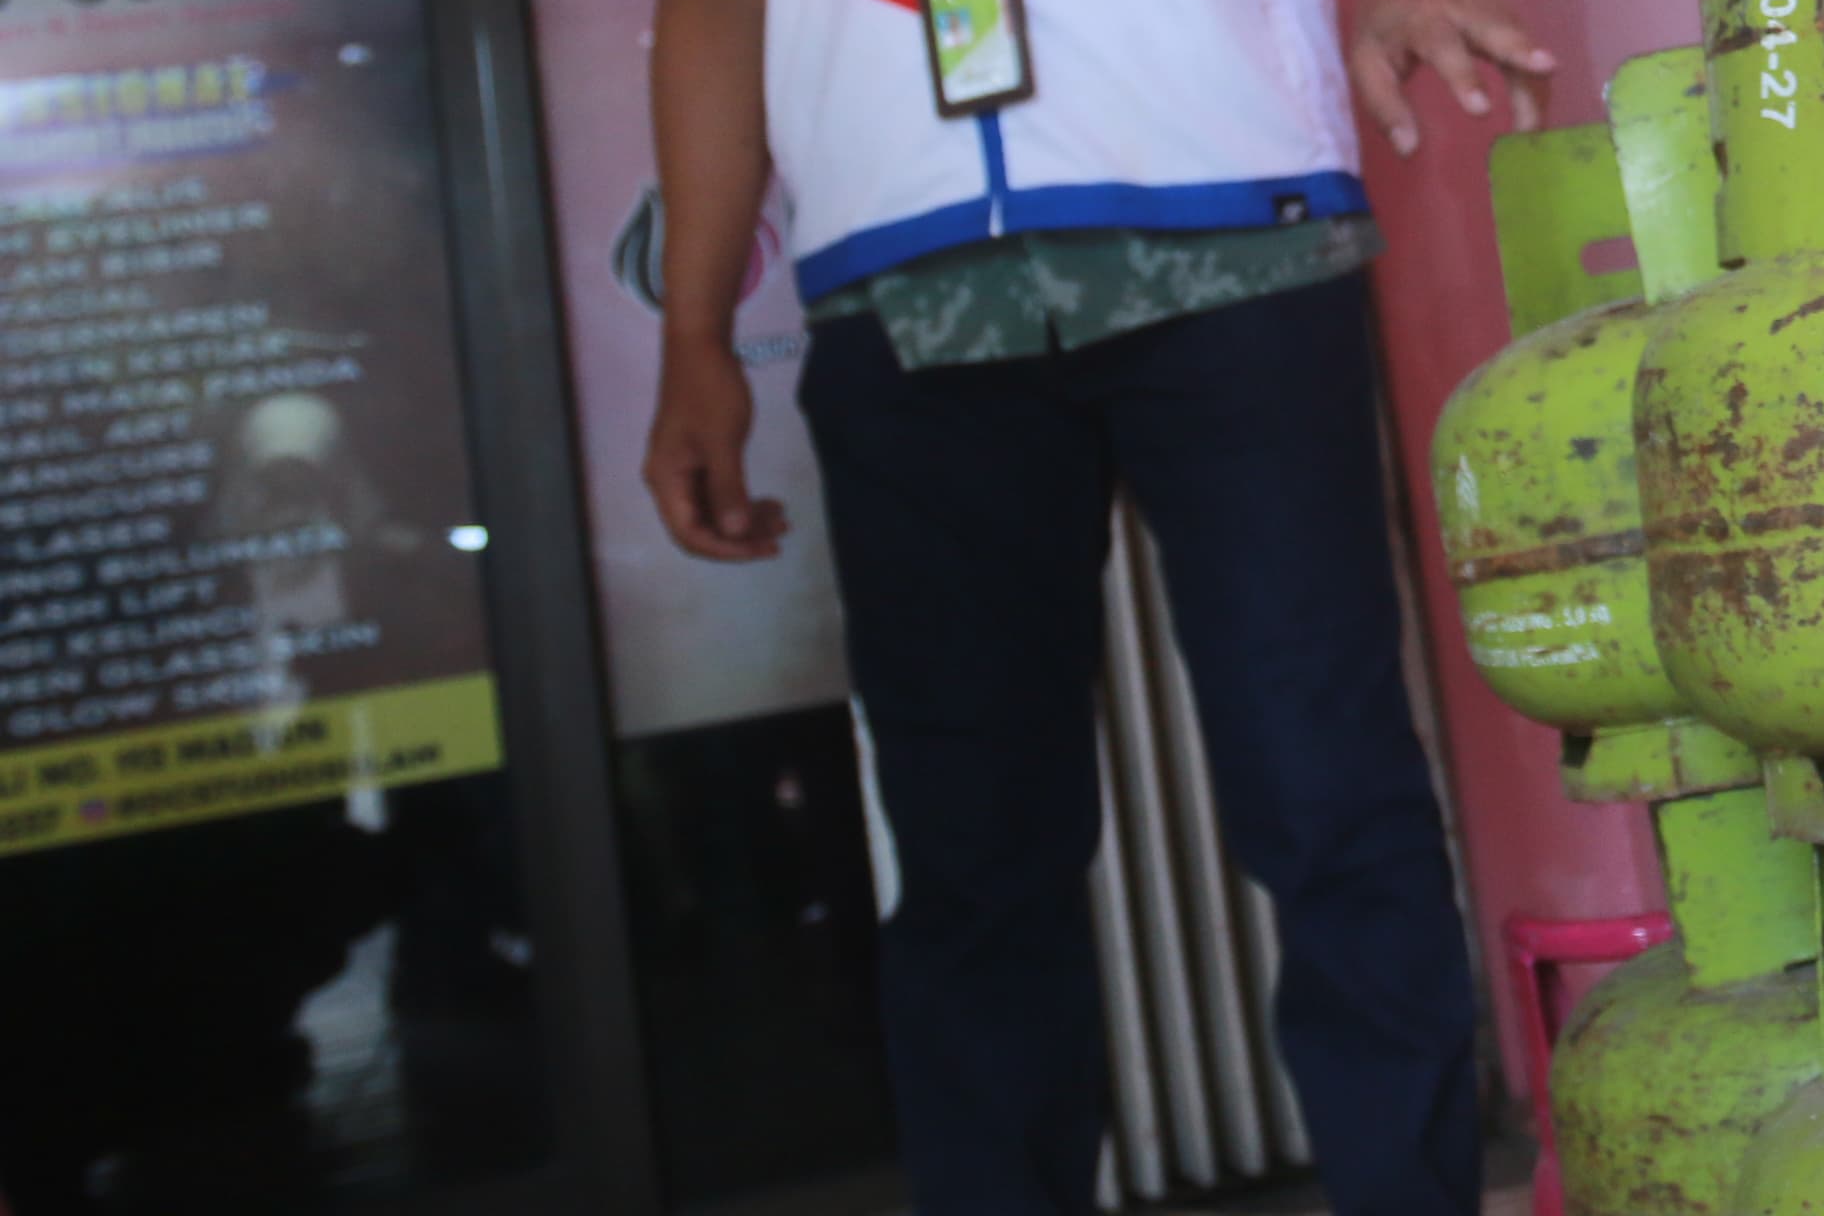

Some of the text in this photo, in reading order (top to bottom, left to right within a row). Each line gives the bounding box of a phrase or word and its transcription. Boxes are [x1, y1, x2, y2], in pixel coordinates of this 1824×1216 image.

[47, 203, 269, 251] EYELINER
[102, 241, 222, 278] BIBIR
[62, 378, 190, 416] MATA
[204, 356, 362, 396] PANDA
[98, 523, 348, 584] BULUMATA
[268, 620, 380, 664] SKIN
[7, 692, 158, 739] GLOW
